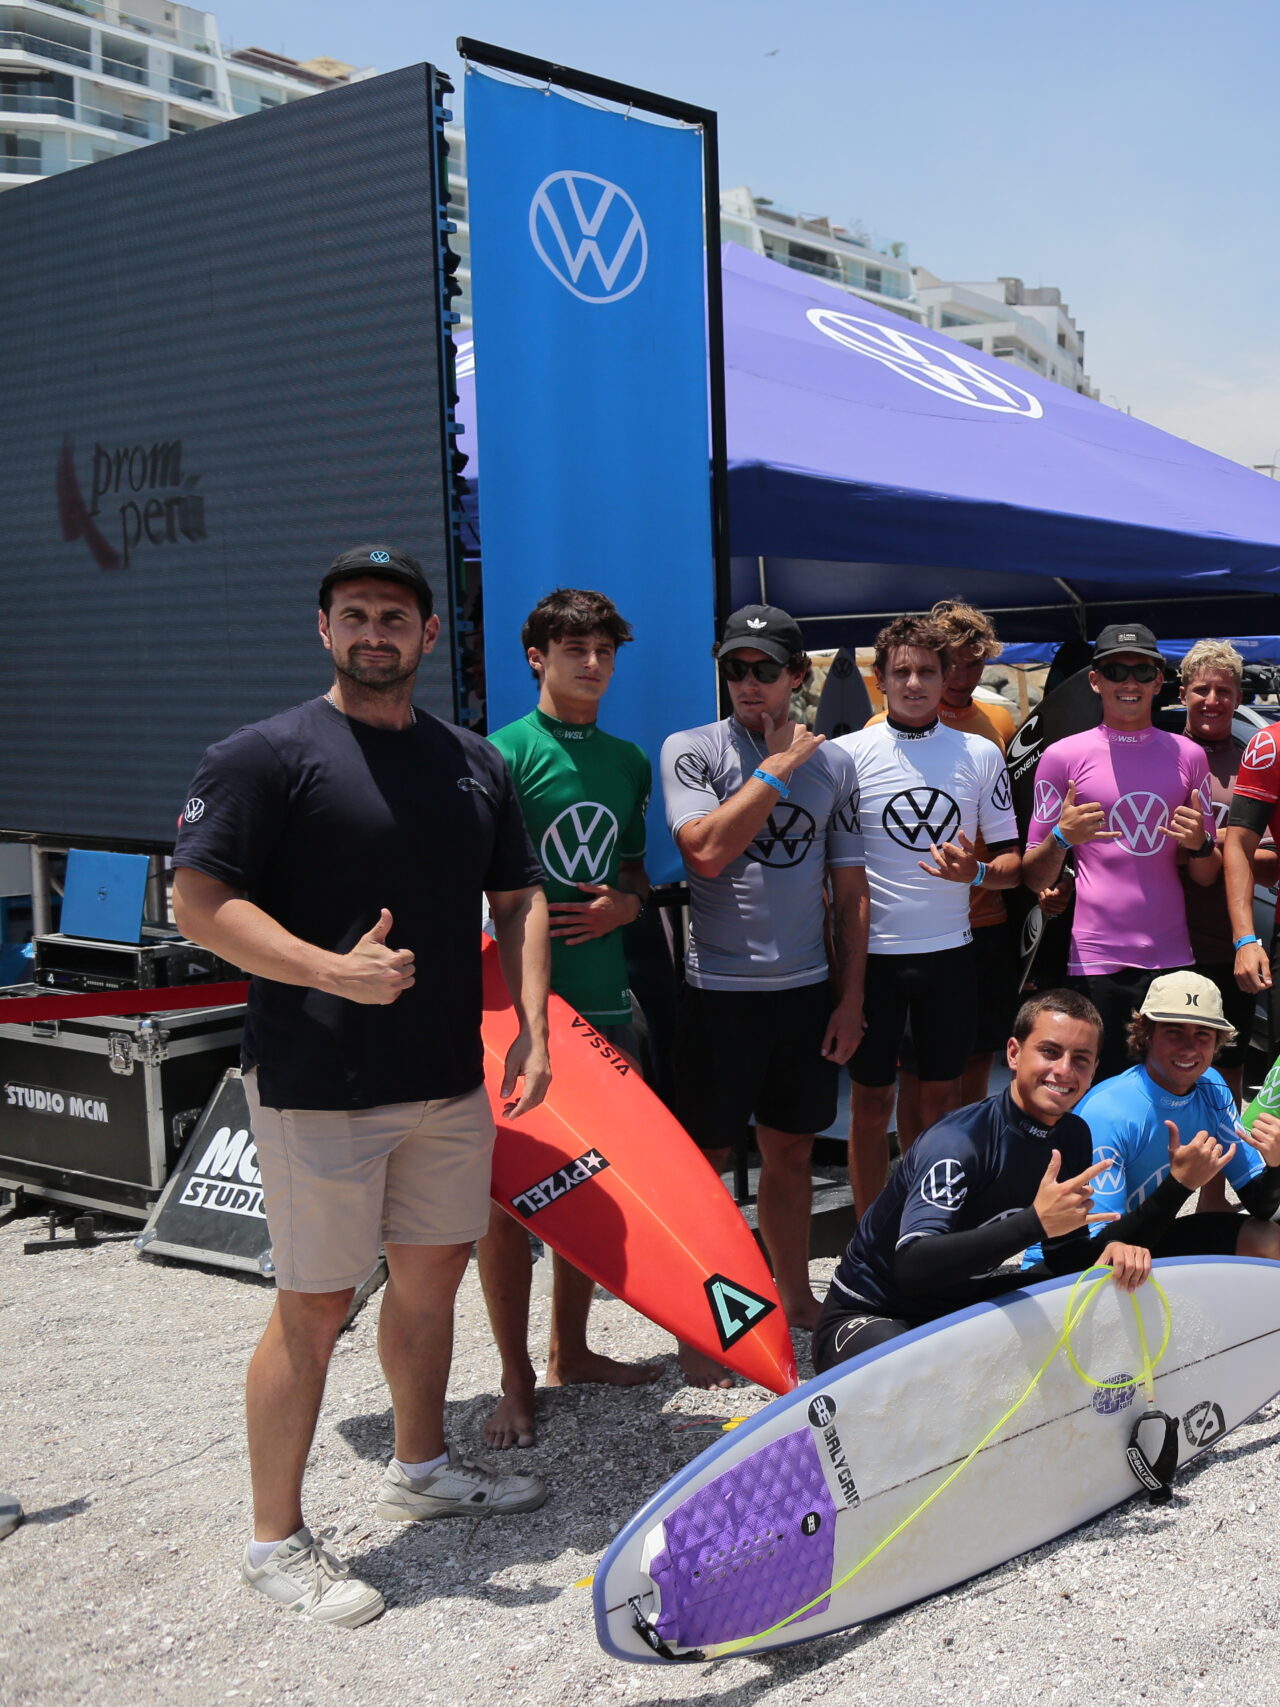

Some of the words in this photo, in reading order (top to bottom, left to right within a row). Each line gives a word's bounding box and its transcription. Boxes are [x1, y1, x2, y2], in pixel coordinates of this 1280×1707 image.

[88, 439, 182, 517] prom
[906, 732, 929, 741] WSL
[1117, 735, 1138, 744] WSL
[571, 1016, 630, 1076] VISSLA
[7, 1086, 65, 1114] STUDIO
[69, 1097, 109, 1123] MCM
[195, 1127, 263, 1185] MC
[512, 1159, 593, 1212] PYZEL
[1134, 1459, 1149, 1477] BALY
